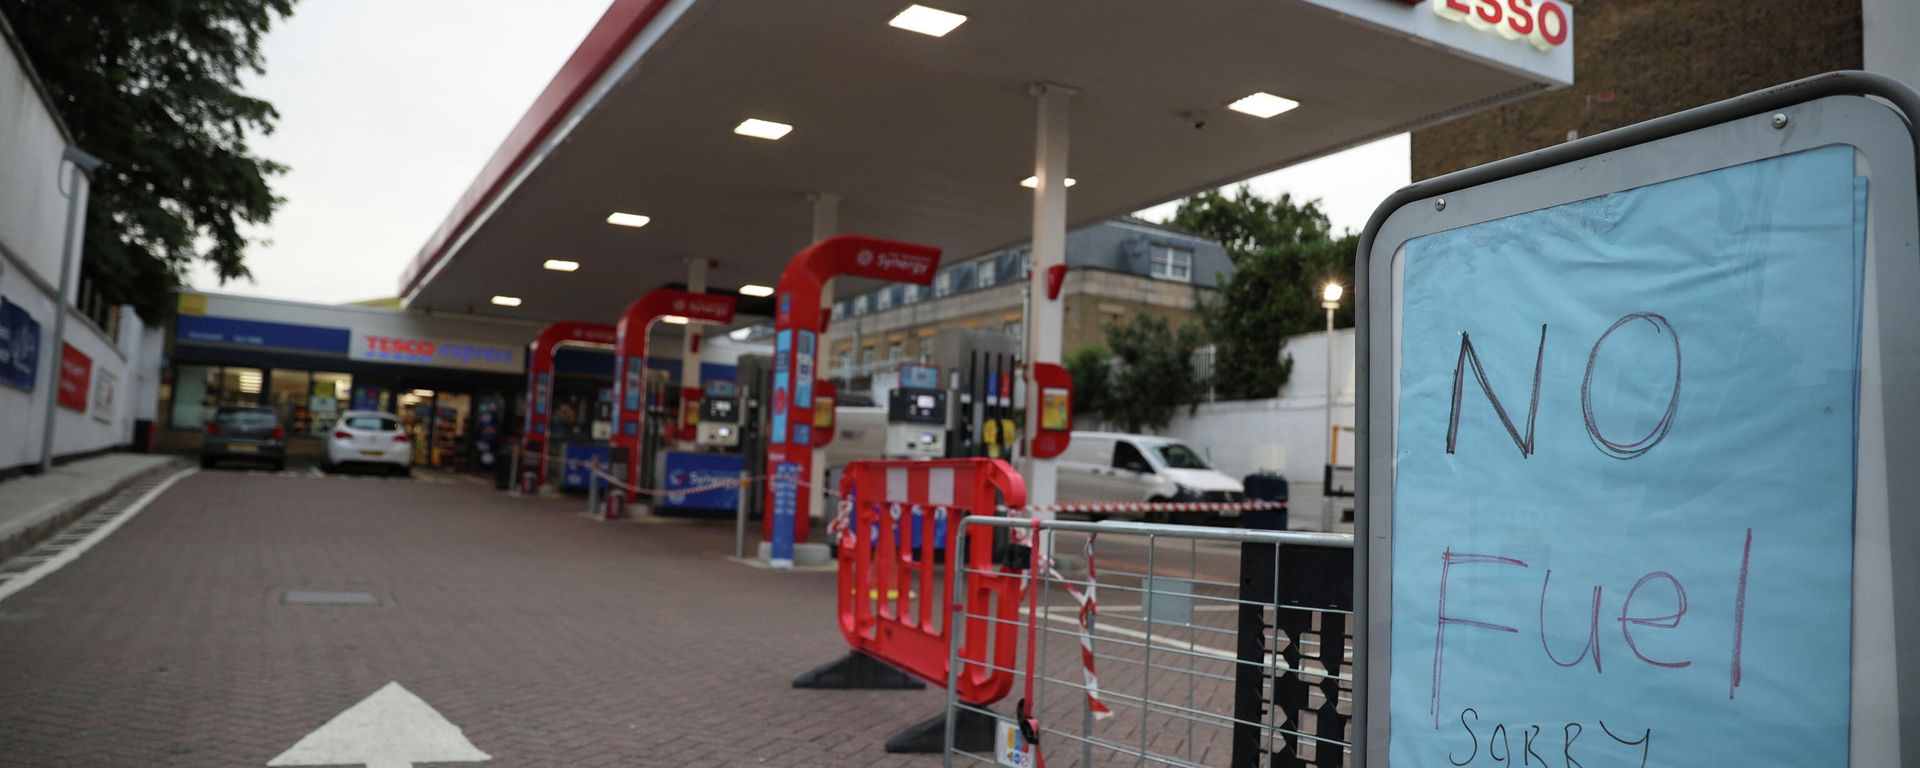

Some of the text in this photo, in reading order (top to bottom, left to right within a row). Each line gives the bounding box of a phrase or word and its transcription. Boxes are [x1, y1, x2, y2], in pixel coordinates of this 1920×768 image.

[366, 336, 436, 356] TESCO
[1445, 311, 1682, 461] NO
[1430, 527, 1753, 731] Fuel
[1448, 707, 1651, 768] SORRY
